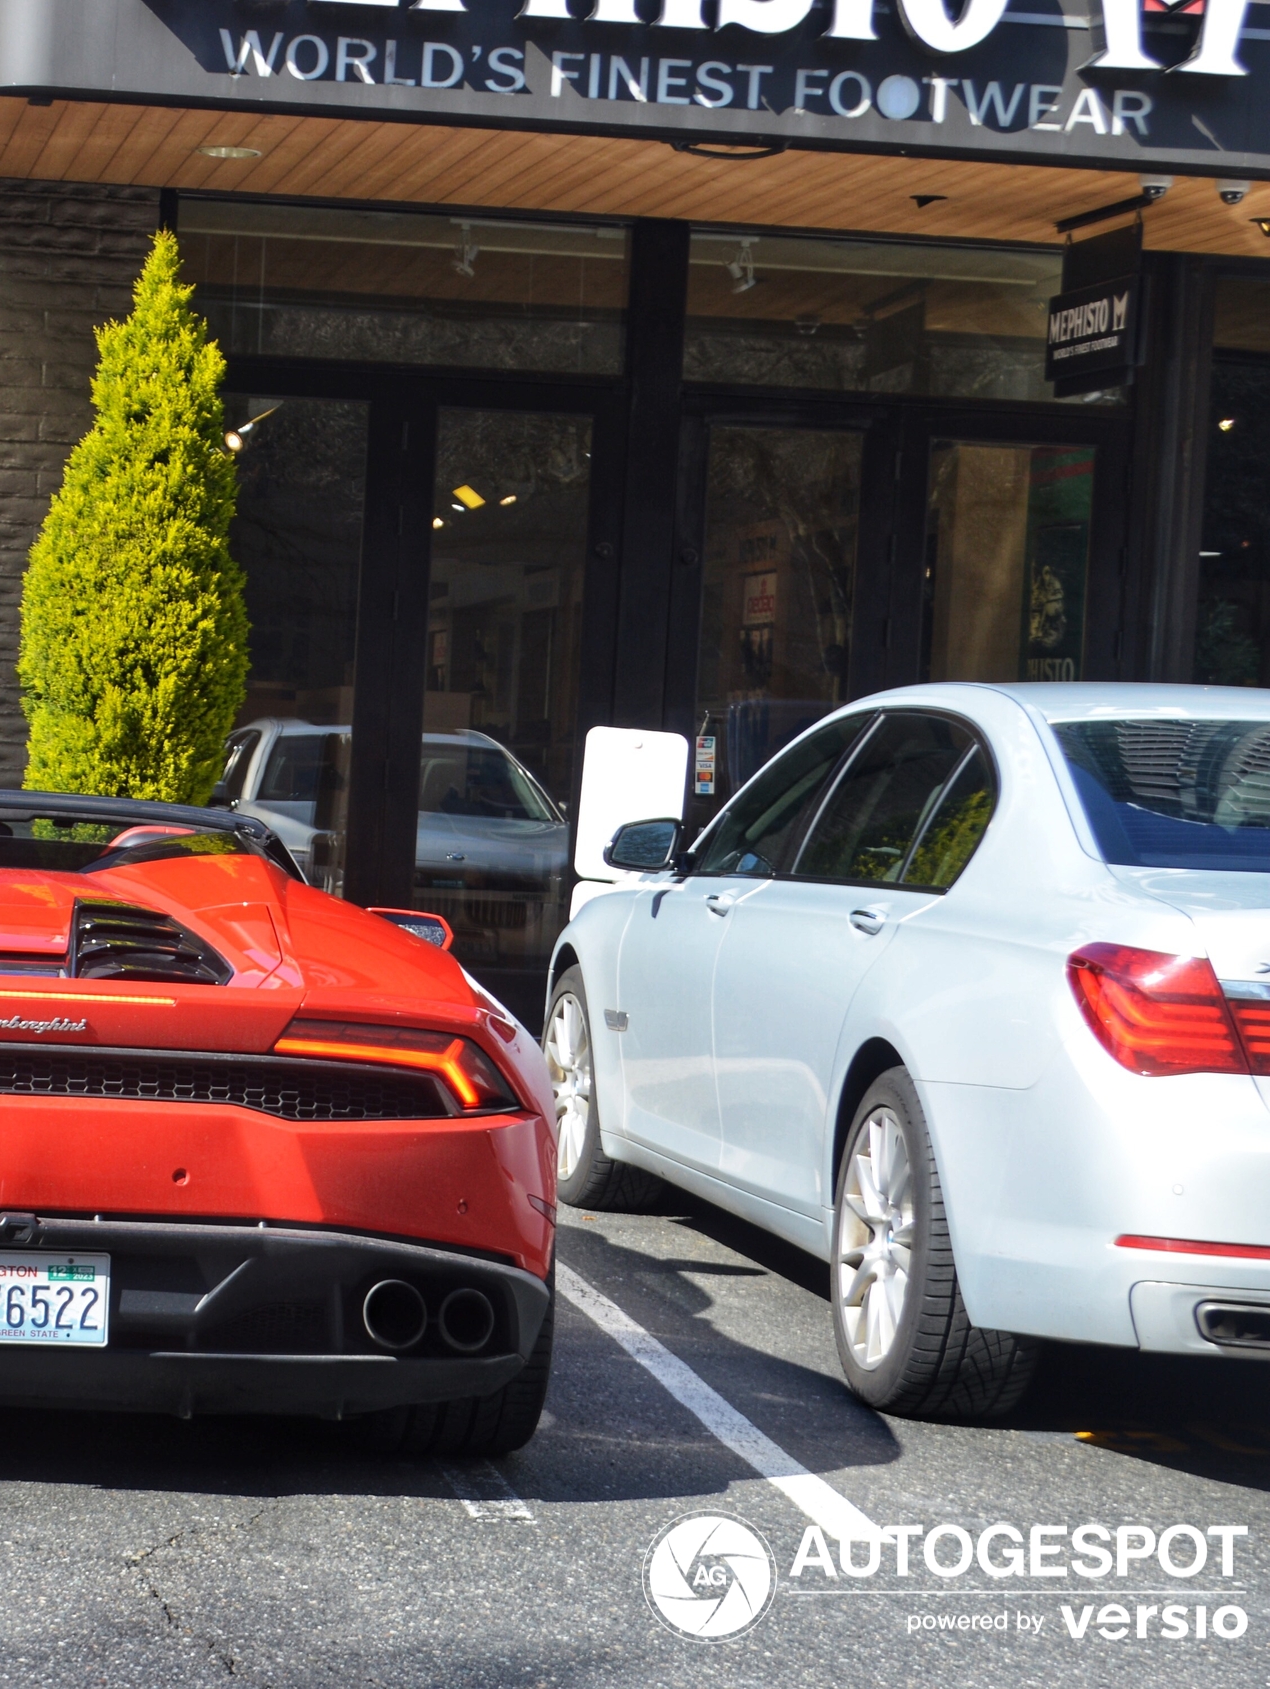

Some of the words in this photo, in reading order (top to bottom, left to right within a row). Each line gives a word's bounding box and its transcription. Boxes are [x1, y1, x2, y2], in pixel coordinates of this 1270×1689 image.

[219, 28, 525, 95] WORLD'S
[551, 50, 773, 110] FINEST
[794, 68, 1153, 137] FOOTWEAR
[1048, 298, 1109, 345] MEPHISTO
[50, 1266, 67, 1277] 12
[30, 1330, 59, 1338] STATE
